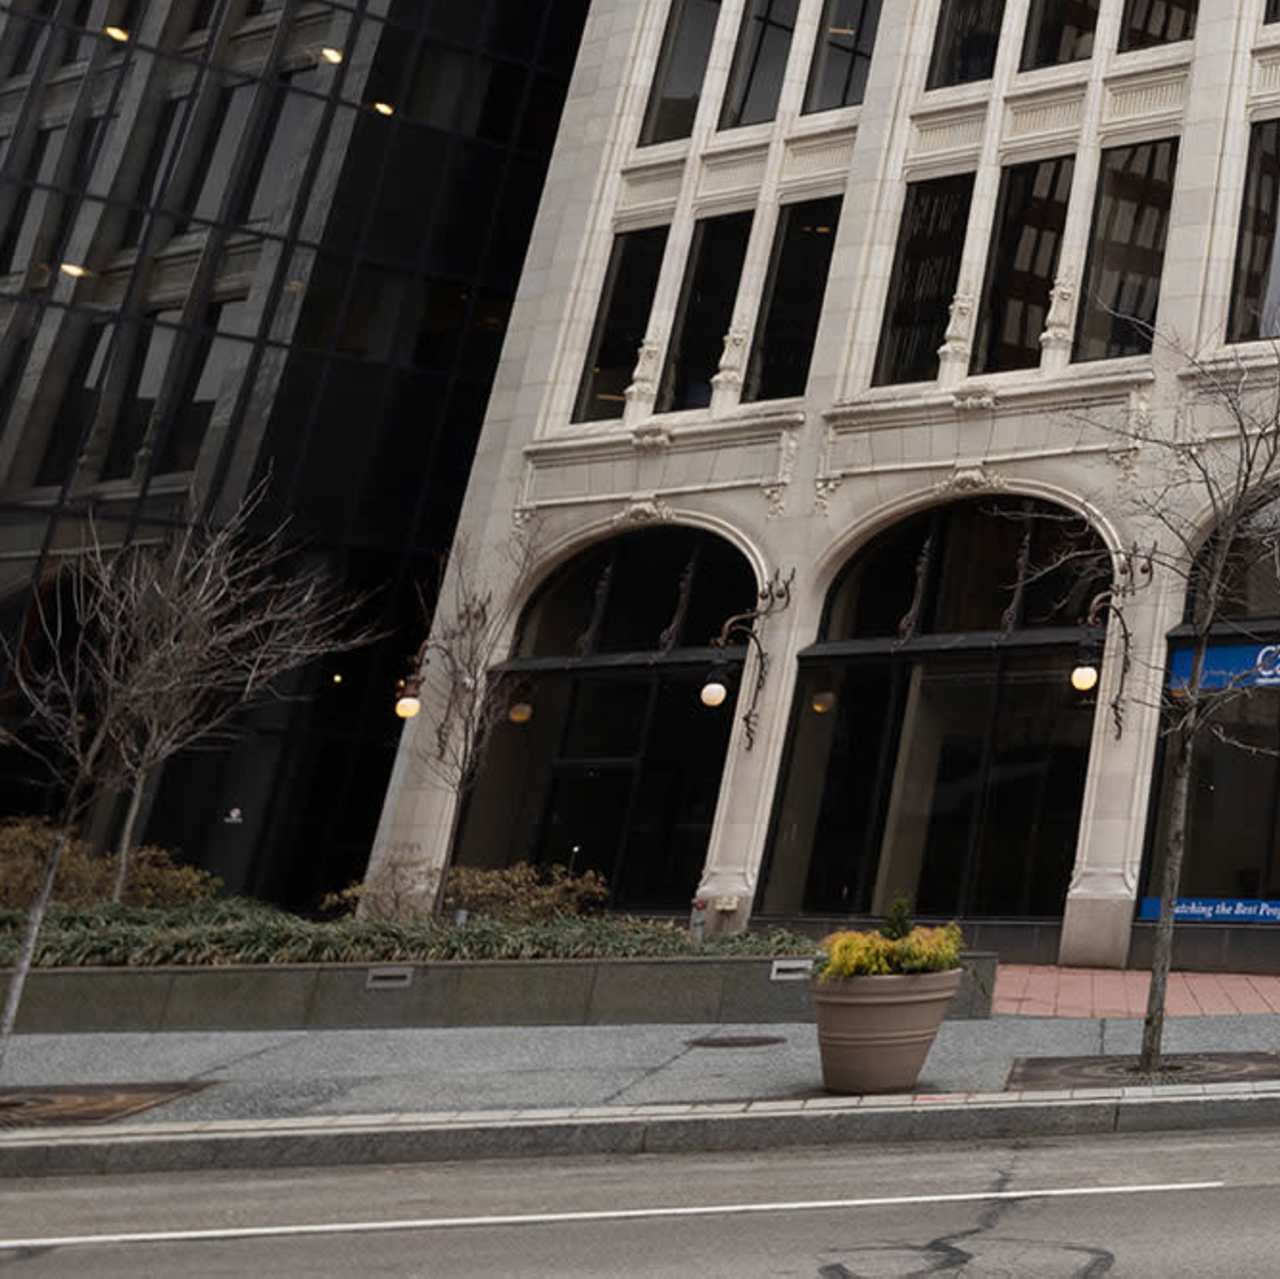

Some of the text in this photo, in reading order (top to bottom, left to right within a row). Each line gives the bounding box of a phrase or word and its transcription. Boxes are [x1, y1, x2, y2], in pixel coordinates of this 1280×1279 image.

[1173, 901, 1213, 918] atching
[1215, 901, 1232, 915] the
[1233, 902, 1258, 915] Best
